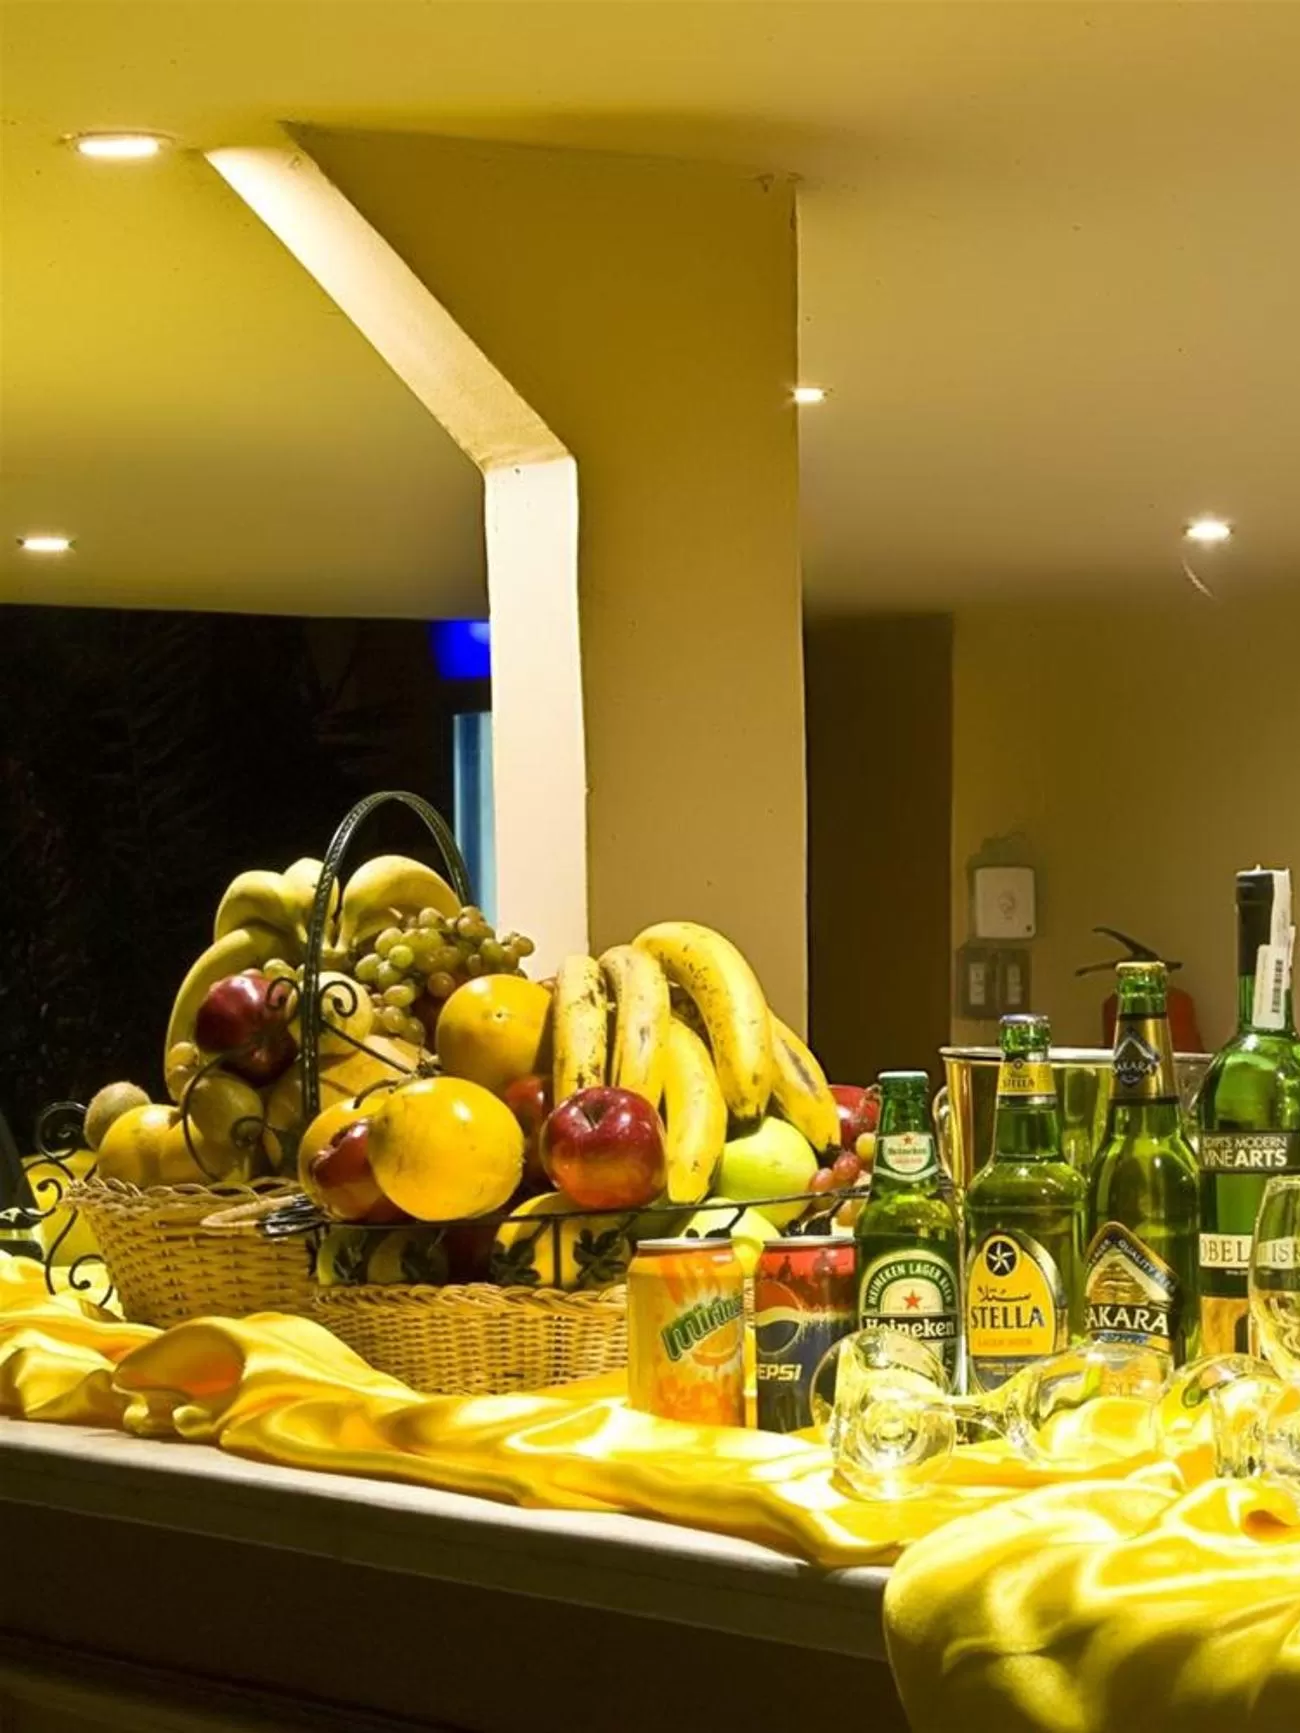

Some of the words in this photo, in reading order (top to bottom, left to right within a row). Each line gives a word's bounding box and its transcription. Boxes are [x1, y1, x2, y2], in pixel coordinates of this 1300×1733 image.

[1235, 1136, 1288, 1150] MODERN
[971, 1306, 1046, 1329] STELLA
[757, 1363, 803, 1381] EPSI
